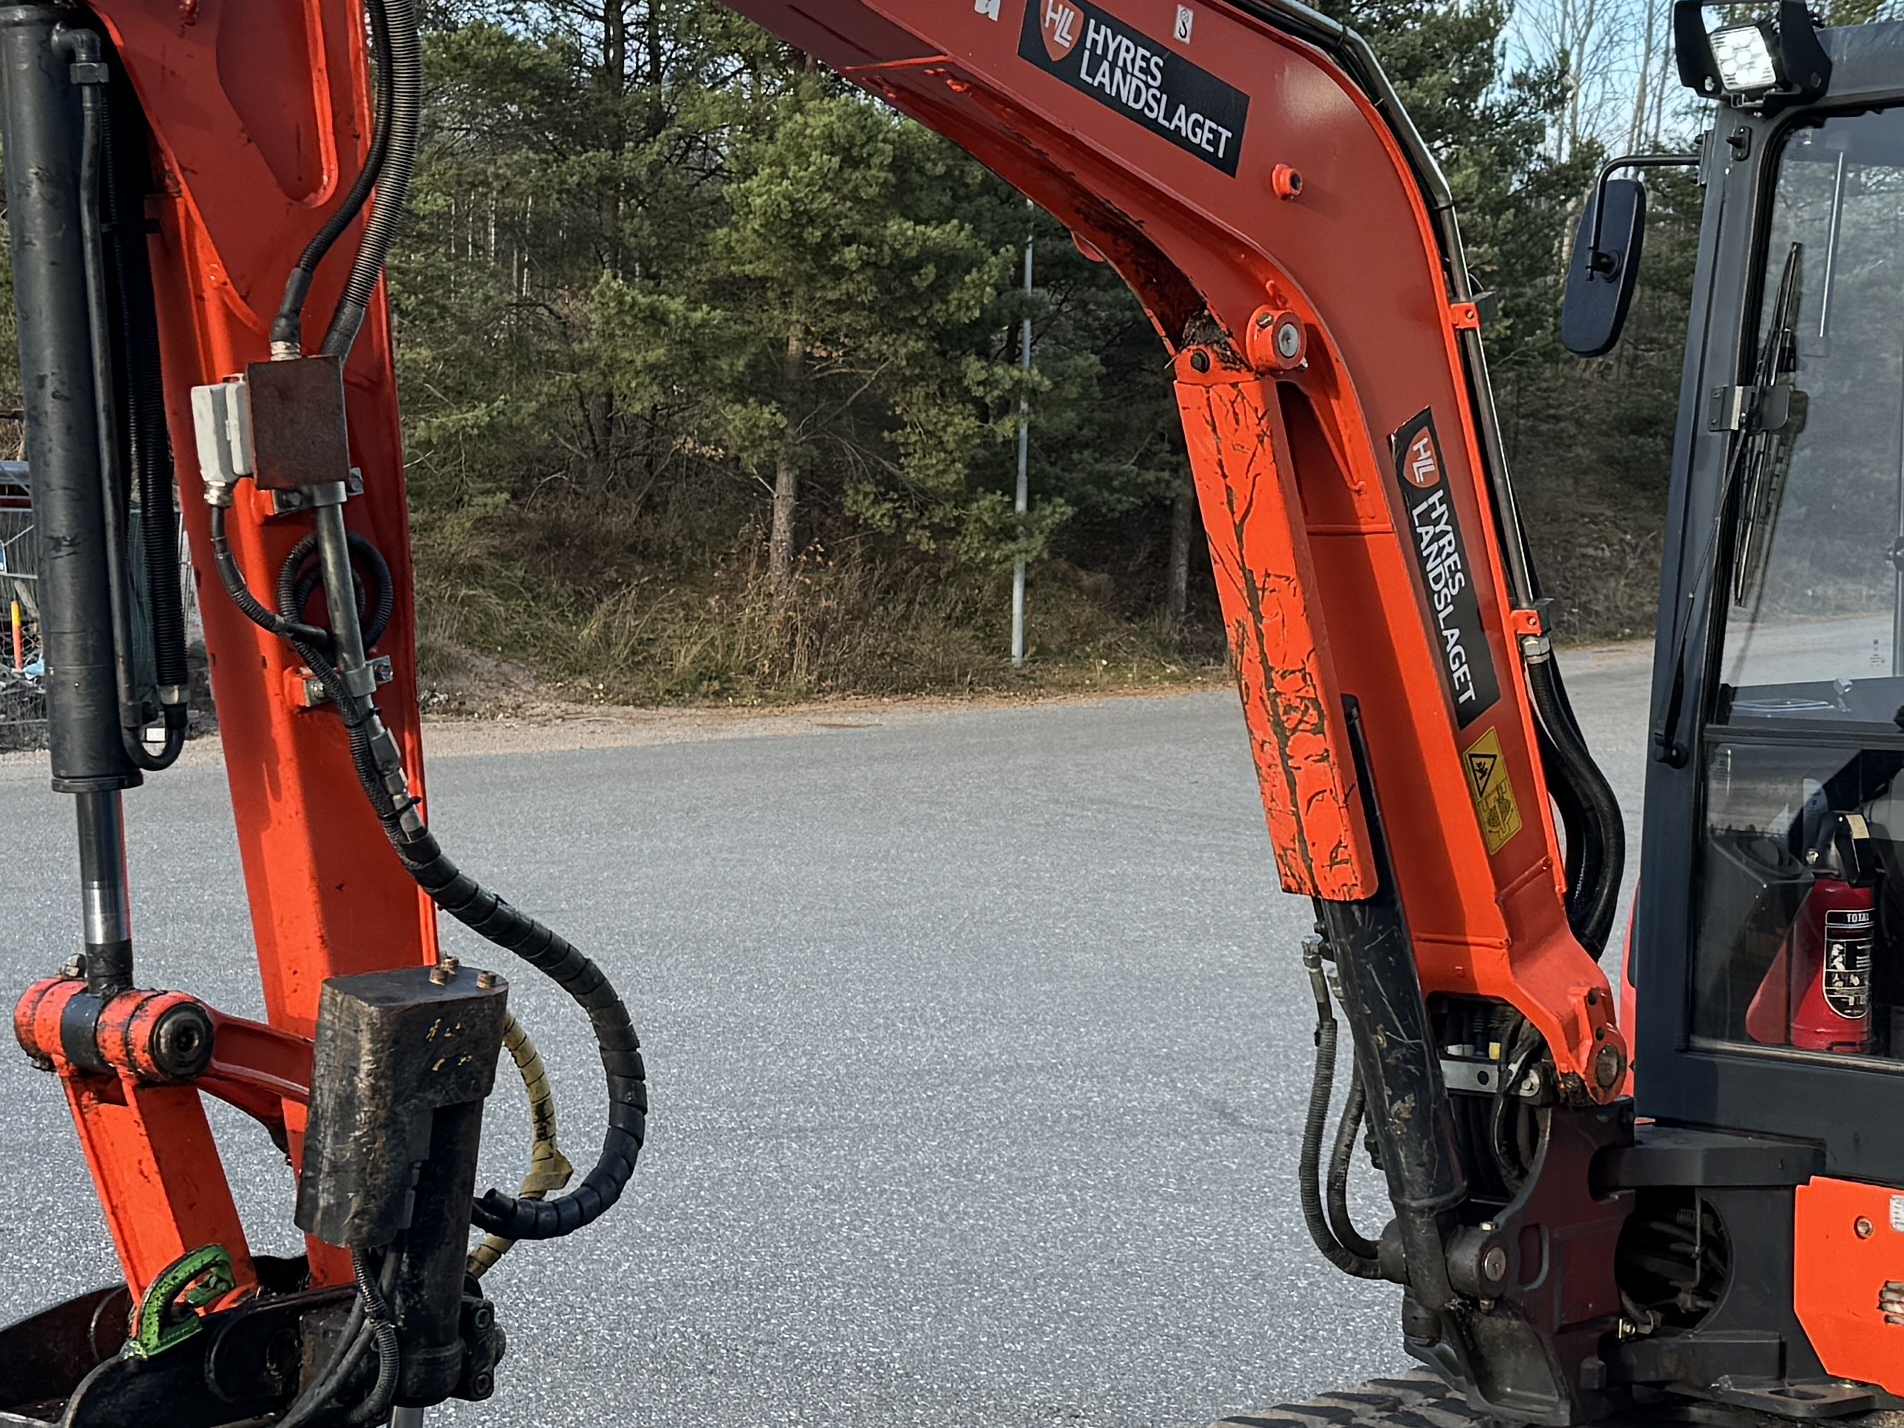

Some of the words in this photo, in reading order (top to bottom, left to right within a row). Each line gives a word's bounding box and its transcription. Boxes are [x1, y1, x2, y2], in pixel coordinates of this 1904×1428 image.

[1079, 49, 1233, 159] LANDSLAGET
[1084, 18, 1164, 88] HYRES
[1427, 489, 1465, 596] HYRES
[1411, 500, 1476, 704] LANDSLAGET
